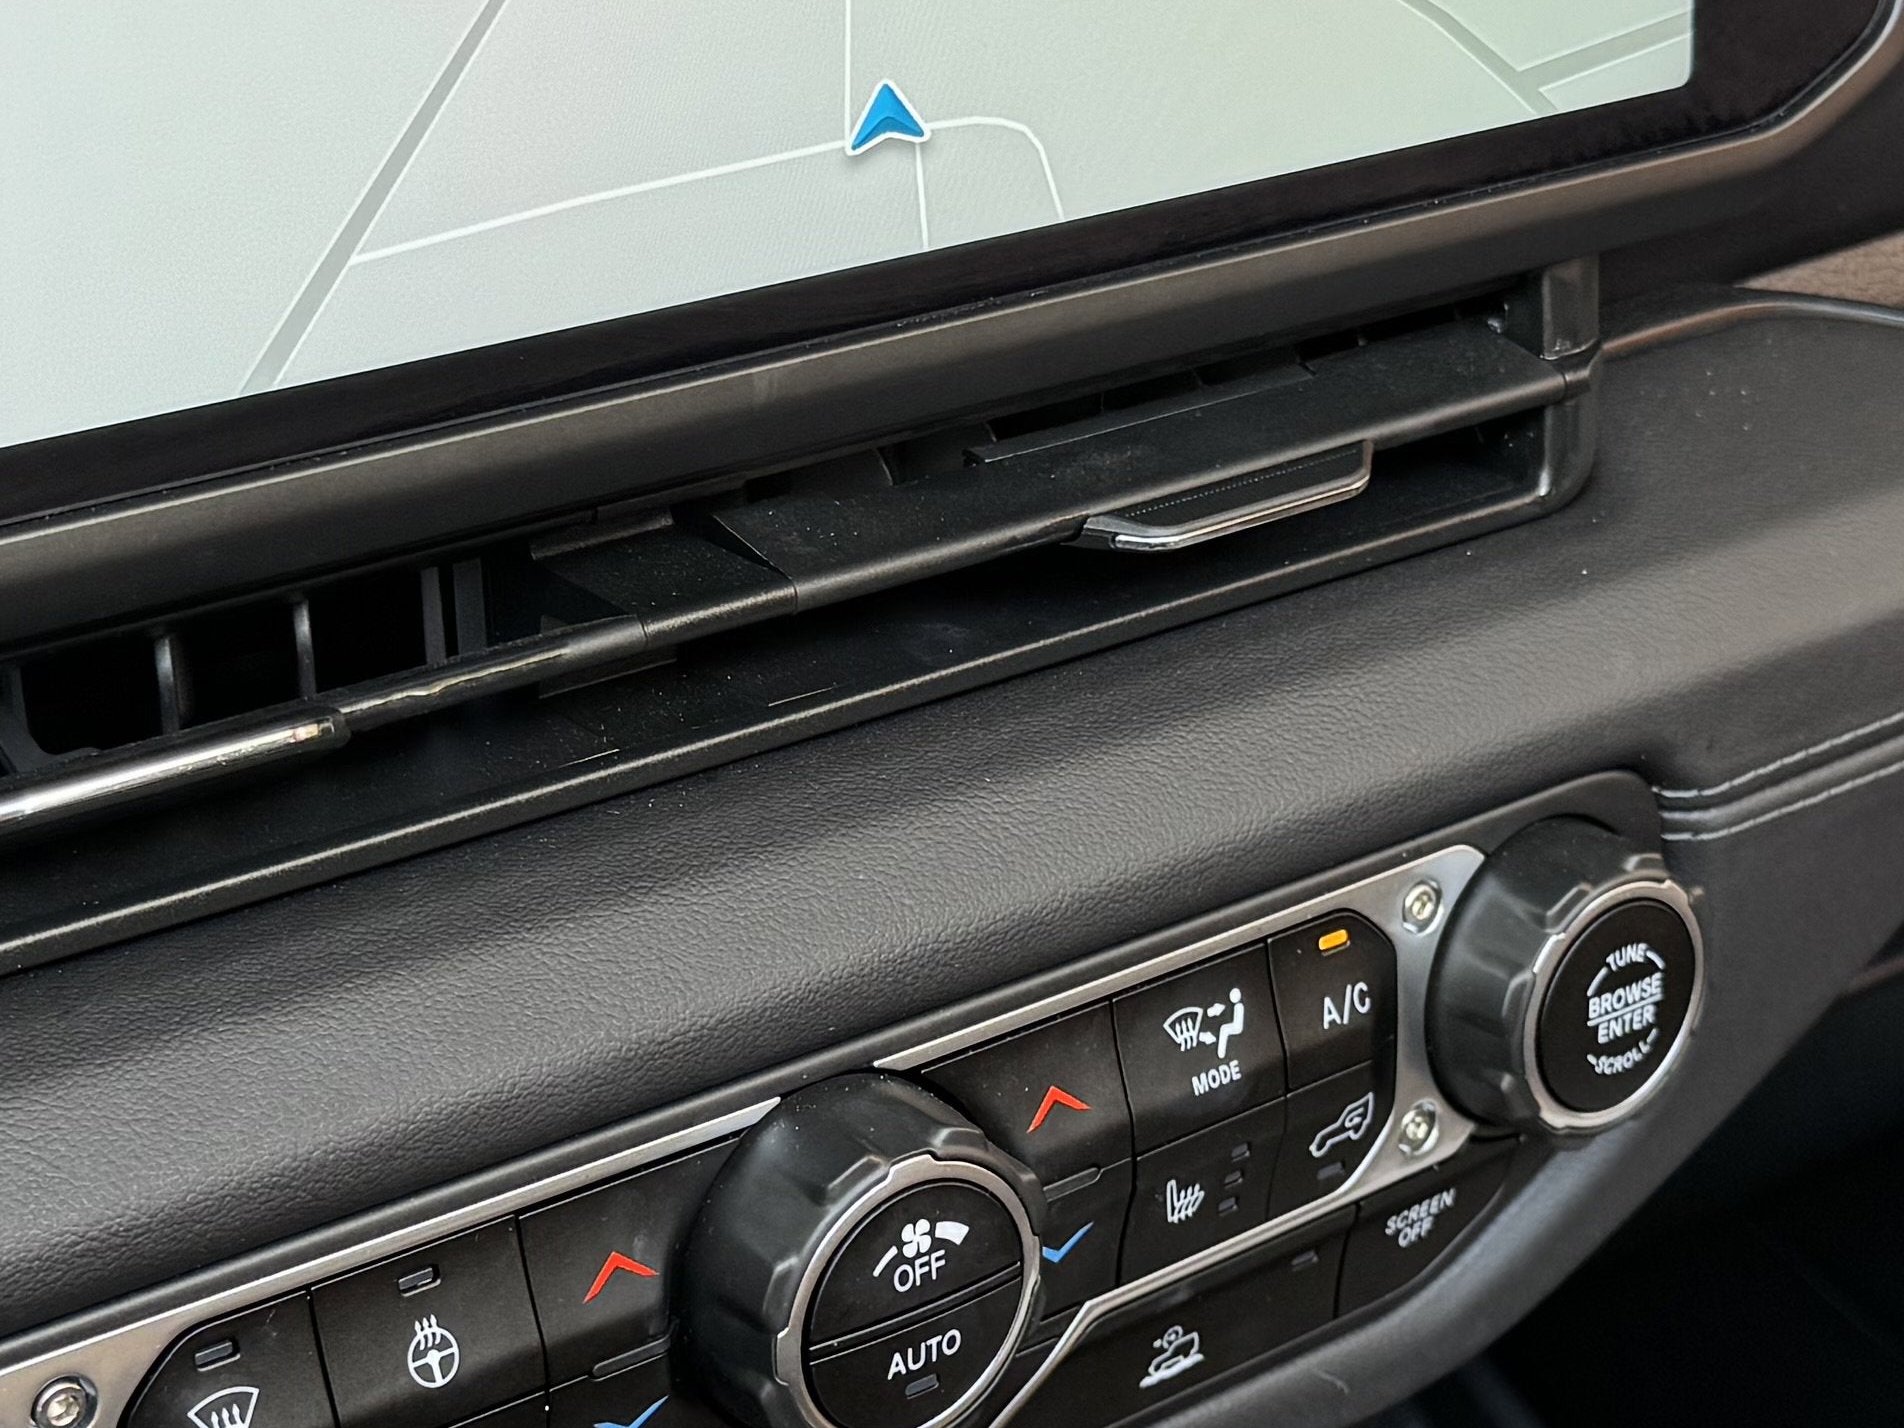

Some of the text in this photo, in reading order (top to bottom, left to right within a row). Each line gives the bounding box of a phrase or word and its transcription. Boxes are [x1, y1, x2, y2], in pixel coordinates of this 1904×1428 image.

[1606, 942, 1647, 971] TUNE
[1322, 982, 1371, 1030] A/C
[1587, 971, 1663, 1019] BROWSE
[1597, 1004, 1656, 1044] ENTER
[1594, 1038, 1651, 1075] SCROLL
[1192, 1062, 1242, 1096] MODE
[1385, 1188, 1455, 1236] SCREEN
[1397, 1215, 1435, 1248] OFF
[893, 1251, 946, 1292] OFF
[886, 1329, 962, 1380] AUTO
